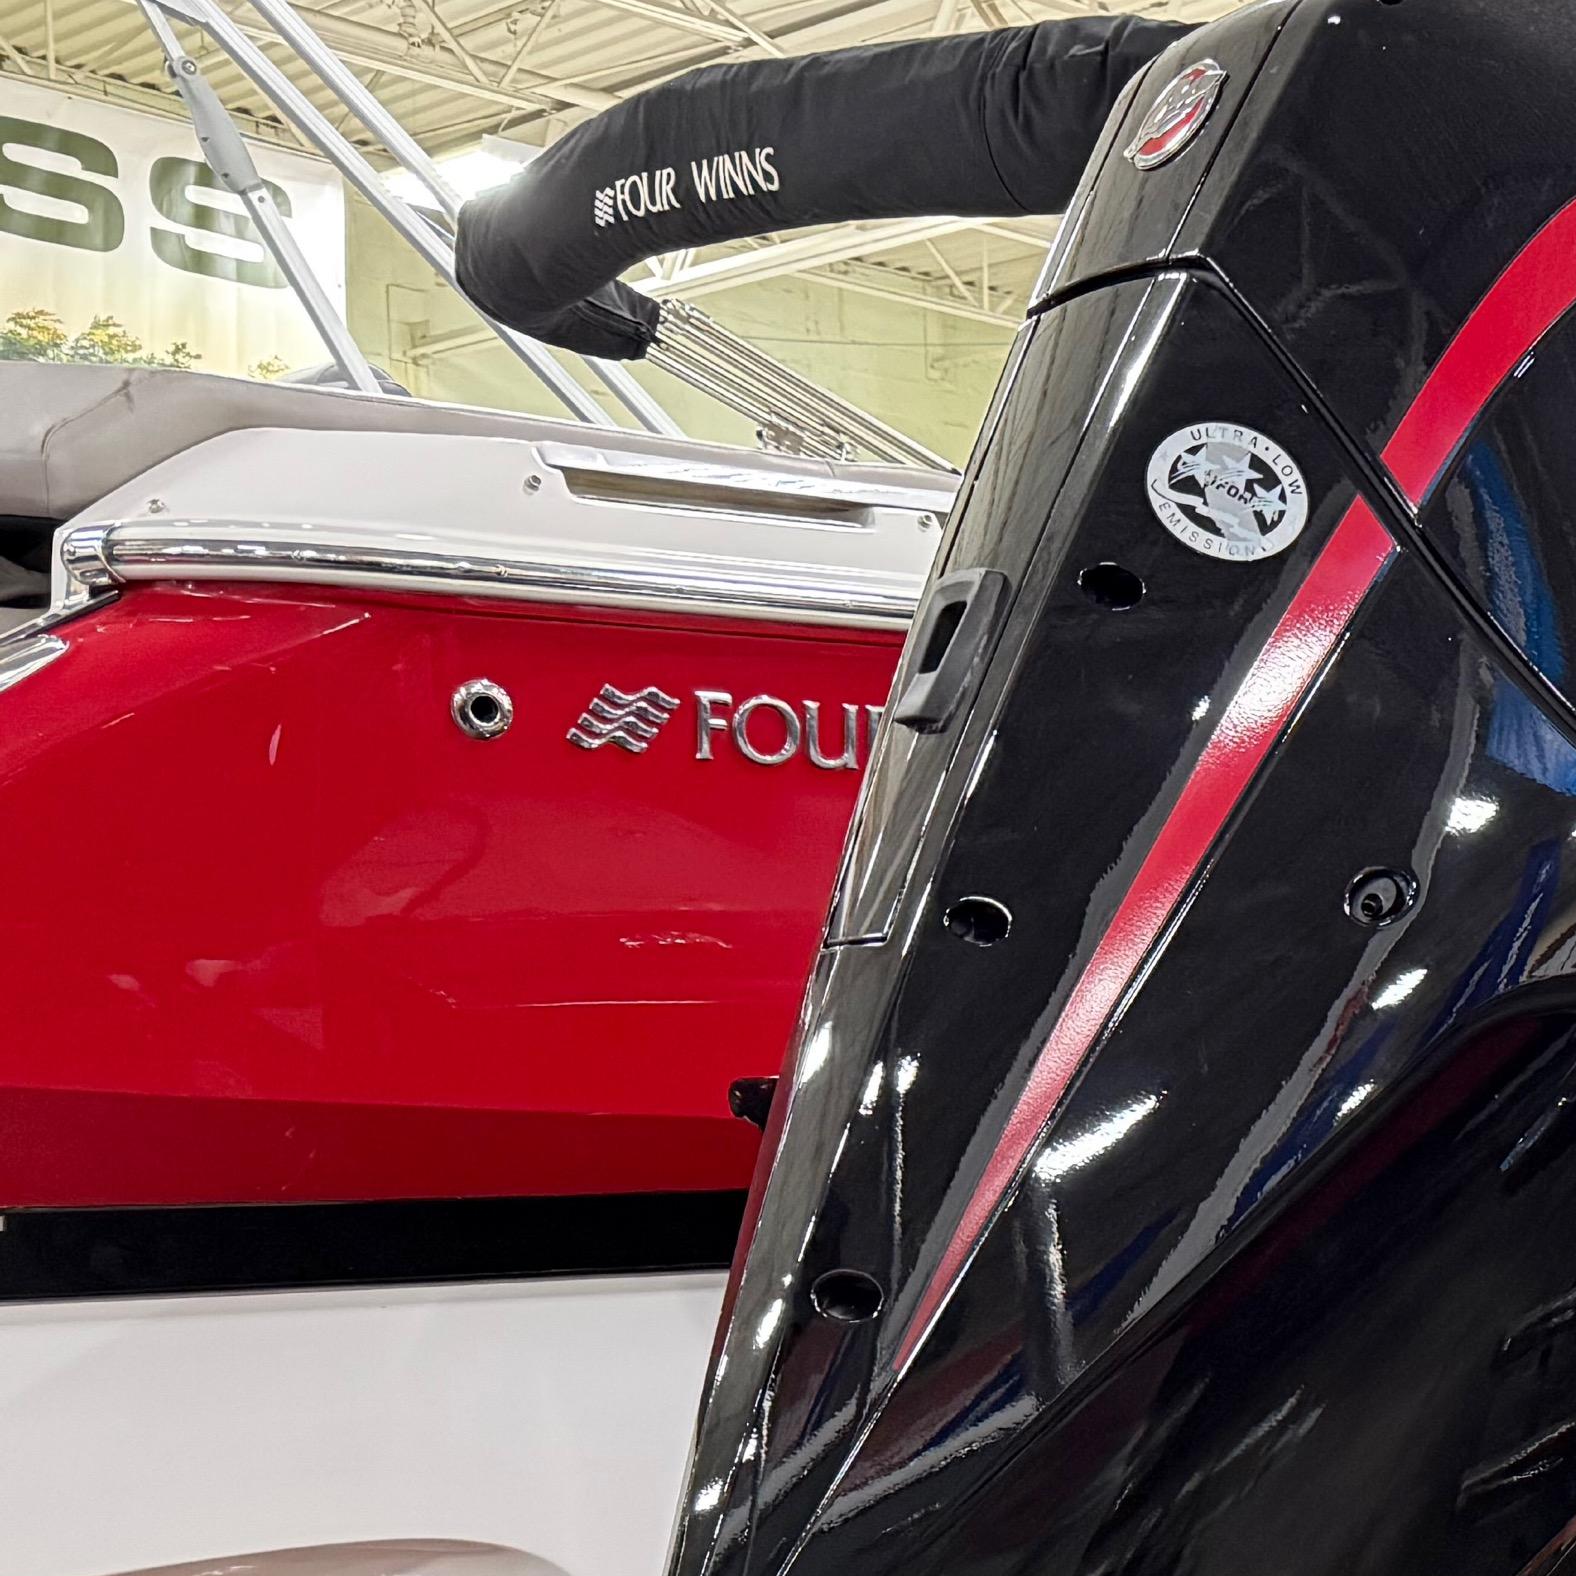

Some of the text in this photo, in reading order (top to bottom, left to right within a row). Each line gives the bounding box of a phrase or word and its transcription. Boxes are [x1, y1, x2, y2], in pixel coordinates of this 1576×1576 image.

[615, 147, 780, 221] FOUR WINNS
[1190, 427, 1257, 449] ULTRA
[1272, 454, 1303, 496] LOW
[1158, 502, 1256, 557] EMISSION
[694, 689, 885, 769] FOU
